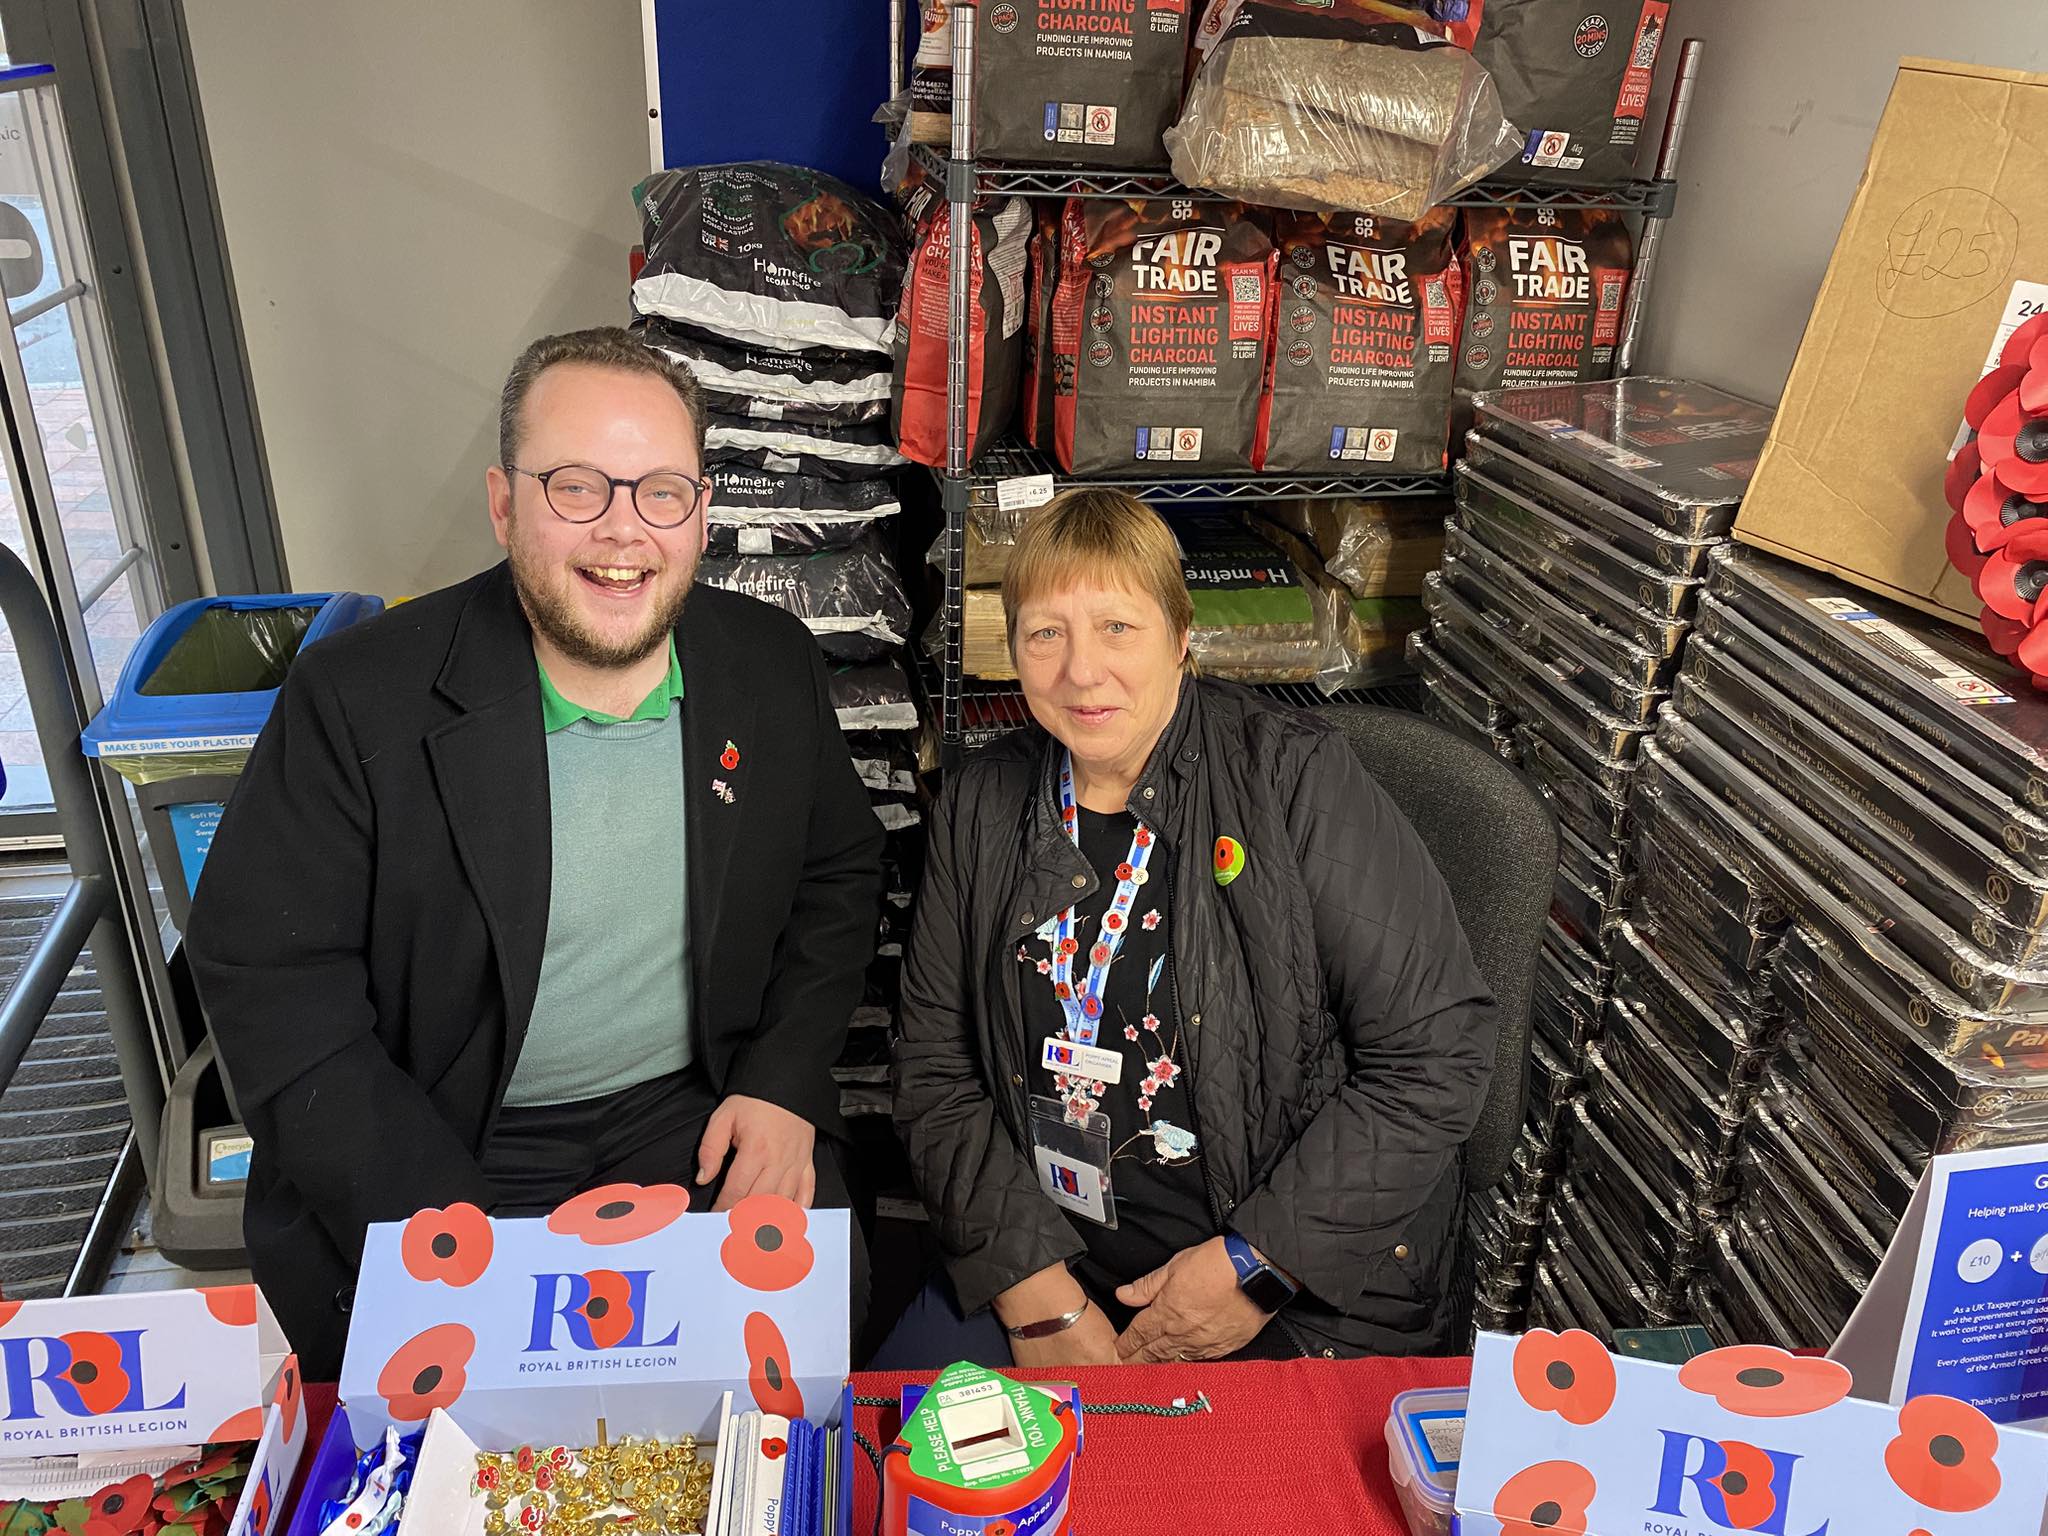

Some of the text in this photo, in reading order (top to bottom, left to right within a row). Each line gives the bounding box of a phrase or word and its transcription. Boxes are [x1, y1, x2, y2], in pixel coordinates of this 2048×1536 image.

[1038, 14, 1134, 34] CHARCOAL
[1157, 25, 1179, 34] LIGHT
[1581, 17, 1604, 31] READY
[1036, 33, 1133, 48] FUNDING LIFE IMPROVING
[1036, 46, 1132, 60] PROJECTS IN NAMIBIA
[1621, 94, 1645, 107] LIVES
[1571, 144, 1583, 156] 4kg
[724, 213, 752, 222] SMOKE
[702, 218, 722, 230] LONG
[724, 226, 754, 236] LASTING
[702, 236, 717, 248] UK
[1132, 232, 1222, 266] FAIR
[1885, 209, 1995, 289] £25
[1327, 245, 1407, 284] FAIR
[1508, 240, 1590, 274] FAIR
[754, 258, 822, 288] Homefire
[1132, 265, 1217, 292] TRADE
[765, 276, 790, 287] ECOAL
[1512, 273, 1589, 298] TRADE
[1333, 274, 1412, 306] TRADE
[1131, 306, 1218, 325] INSTANT
[1334, 308, 1415, 332] INSTANT
[1510, 312, 1587, 331] INSTANT
[1234, 322, 1258, 332] LIVES
[1428, 326, 1450, 336] LIVES
[1596, 329, 1614, 338] LIVES
[1130, 328, 1219, 346] LIGHTING
[1332, 328, 1414, 352] LIGHTING
[1508, 333, 1584, 350] LIGHTING
[1130, 348, 1216, 364] CHARCOAL
[1331, 349, 1414, 368] CHARCOAL
[1506, 353, 1580, 368] CHARCOAL
[1129, 366, 1216, 376] FUNDING LIFE IMPROVING
[1329, 366, 1414, 378] FUNDING LIFE IMPROVING
[1502, 369, 1578, 378] FUNDING LIFE IMPROVING
[1128, 377, 1216, 386] PROJECTS IN NAMIBIA
[1328, 377, 1414, 390] PROJECTS IN NAMIBIA
[1501, 380, 1538, 388] PROJECTS
[716, 473, 785, 489] Homefire
[727, 487, 752, 495] ECOAL
[1185, 568, 1289, 584] Homefire
[1780, 626, 1951, 748] Barbecue safely responsibly
[104, 742, 137, 752] MAKE
[140, 741, 168, 751] SURE
[170, 739, 200, 749] YOUR
[203, 737, 247, 748] PLASTIC
[1752, 712, 1916, 842] Barbecue safely Dispose responsibly
[1742, 749, 1838, 830] Barbecue safely Dispose
[1724, 787, 1820, 869] Barbecue safely Dispose
[1854, 1015, 1904, 1068] Barbecue
[1968, 1202, 2034, 1218] Helping make
[1970, 1255, 1990, 1268] £10
[1953, 1306, 1964, 1314] As
[1987, 1300, 2020, 1312] Taxpayer
[2022, 1298, 2036, 1307] you
[1944, 1318, 1958, 1326] and
[1973, 1311, 2018, 1324] government
[1939, 1328, 1960, 1336] won't
[1962, 1326, 1978, 1334] cost
[1979, 1324, 1994, 1333] you
[1962, 1326, 2044, 1344] complete simple Gift
[518, 1356, 678, 1373] ROYAL BRITISH LEGION
[1937, 1346, 2040, 1368] Every donation makes real
[1966, 1366, 1976, 1374] of
[1989, 1360, 2016, 1370] Armed
[2018, 1358, 2042, 1366] Forces
[960, 1384, 993, 1398] 381453
[1994, 1396, 2008, 1405] you
[2010, 1393, 2021, 1402] for
[2022, 1391, 2040, 1400] your
[1010, 1385, 1047, 1448] THANK YOU
[4, 1420, 188, 1441] ROYAL BRITISH LEGION
[920, 1408, 952, 1472] PLEASE HELP
[764, 1498, 779, 1534] Poppy
[1018, 1496, 1053, 1528] Appeal
